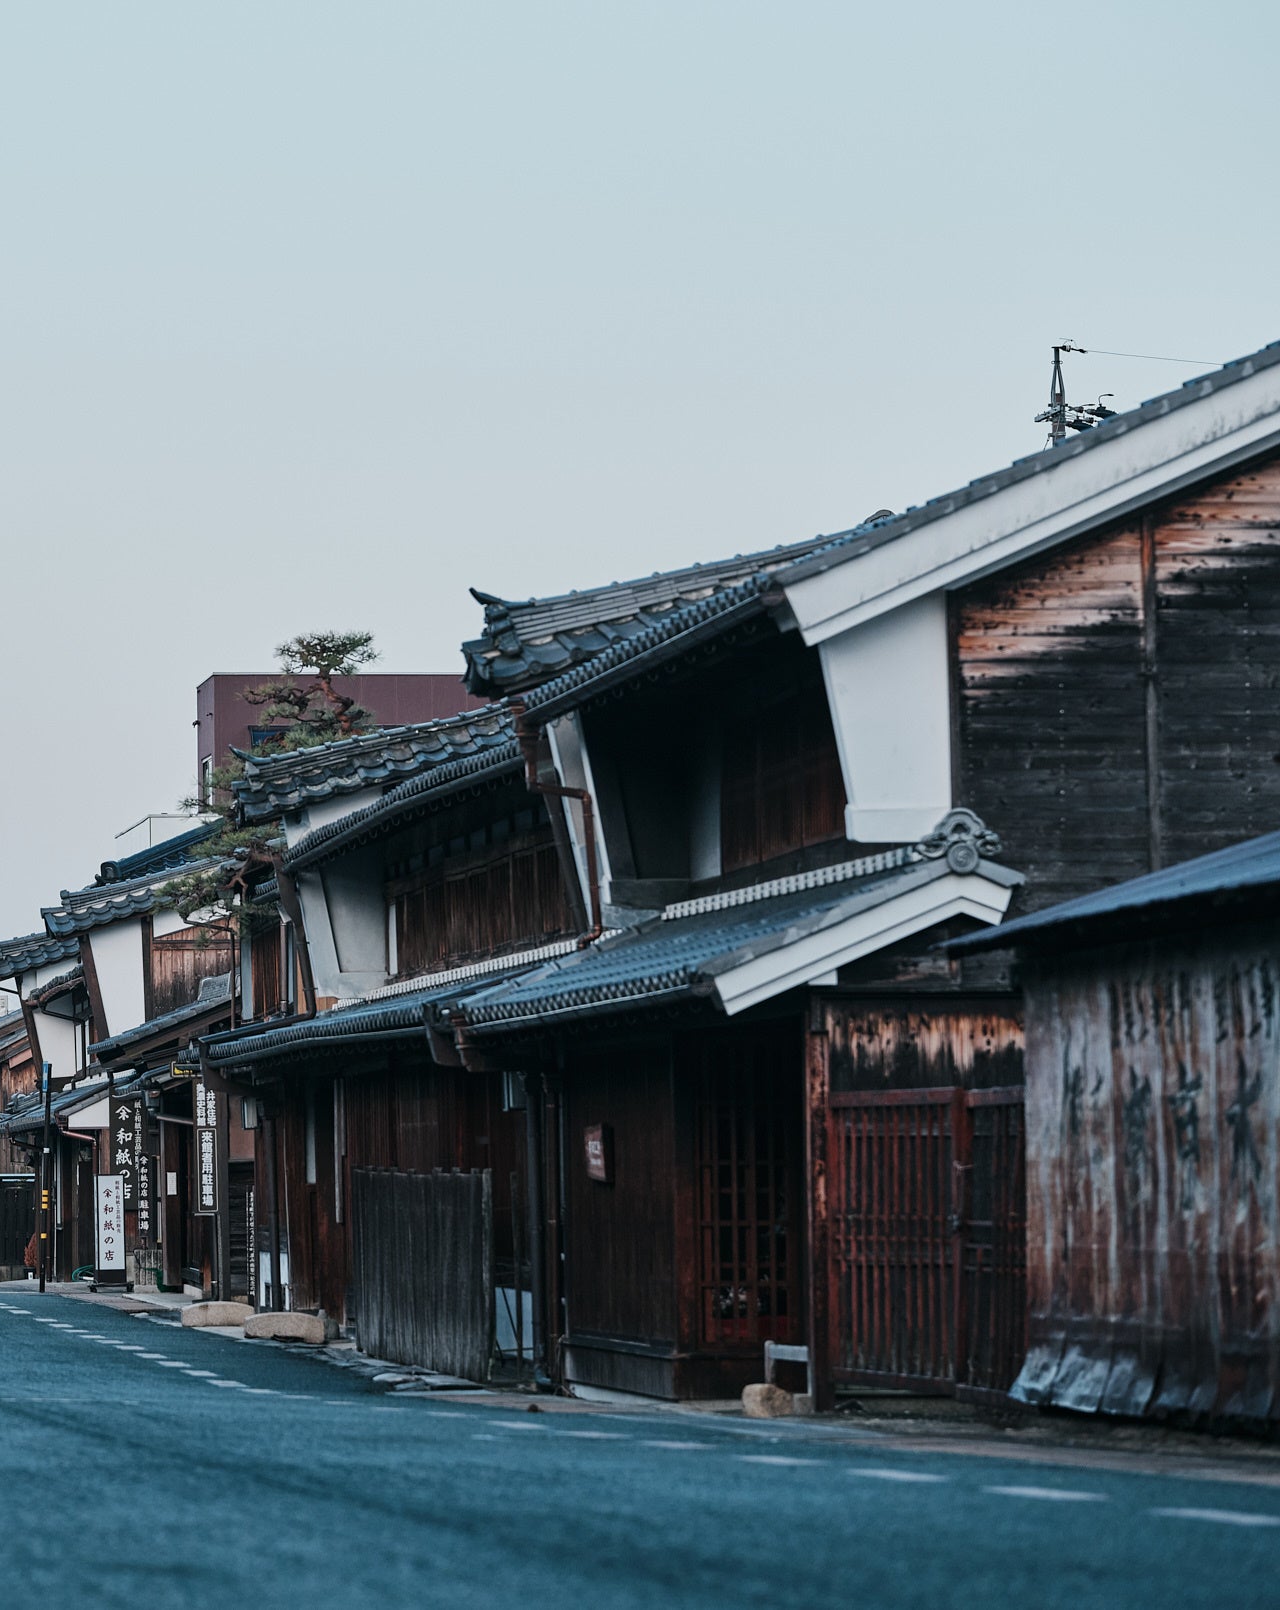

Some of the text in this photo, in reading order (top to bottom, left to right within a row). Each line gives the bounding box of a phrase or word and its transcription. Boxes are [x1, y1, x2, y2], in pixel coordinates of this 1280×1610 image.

[201, 1130, 214, 1206] 来館者用駐車場
